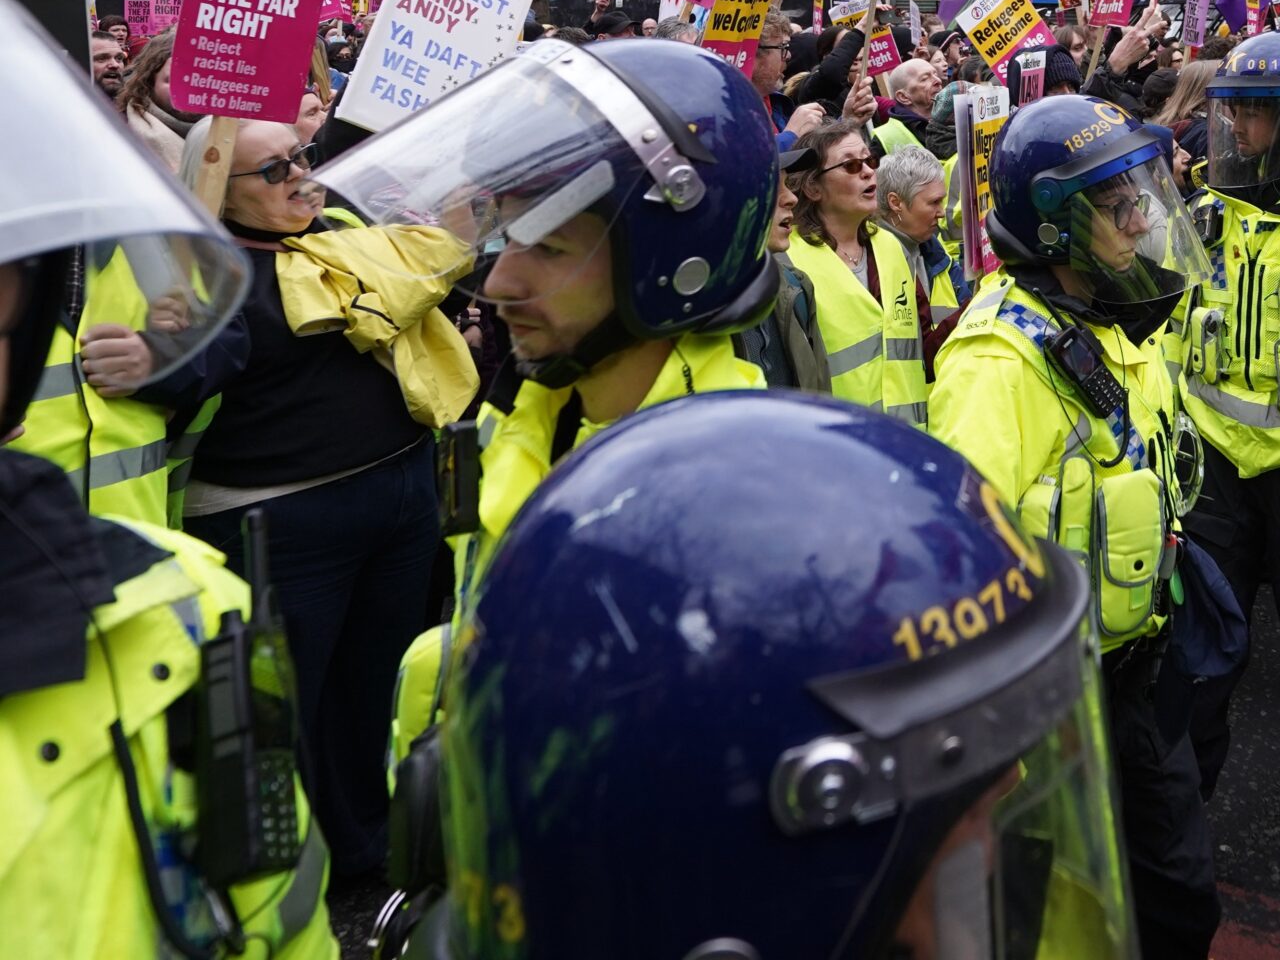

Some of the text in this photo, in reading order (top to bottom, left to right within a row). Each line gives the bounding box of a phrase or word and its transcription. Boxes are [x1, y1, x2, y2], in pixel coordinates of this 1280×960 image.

[128, 8, 141, 17] THE
[154, 5, 181, 16] RIGHT
[195, 3, 273, 40] RIGHT
[197, 35, 242, 56] Reject
[870, 40, 889, 52] the
[984, 11, 1034, 60] welcome
[391, 20, 482, 79] YA DAFT
[868, 51, 893, 68] right
[193, 55, 257, 76] racist lies
[381, 47, 431, 86] WEE
[190, 72, 270, 97] Refugees are
[188, 91, 263, 113] not to blame
[1064, 120, 1112, 153] 18529
